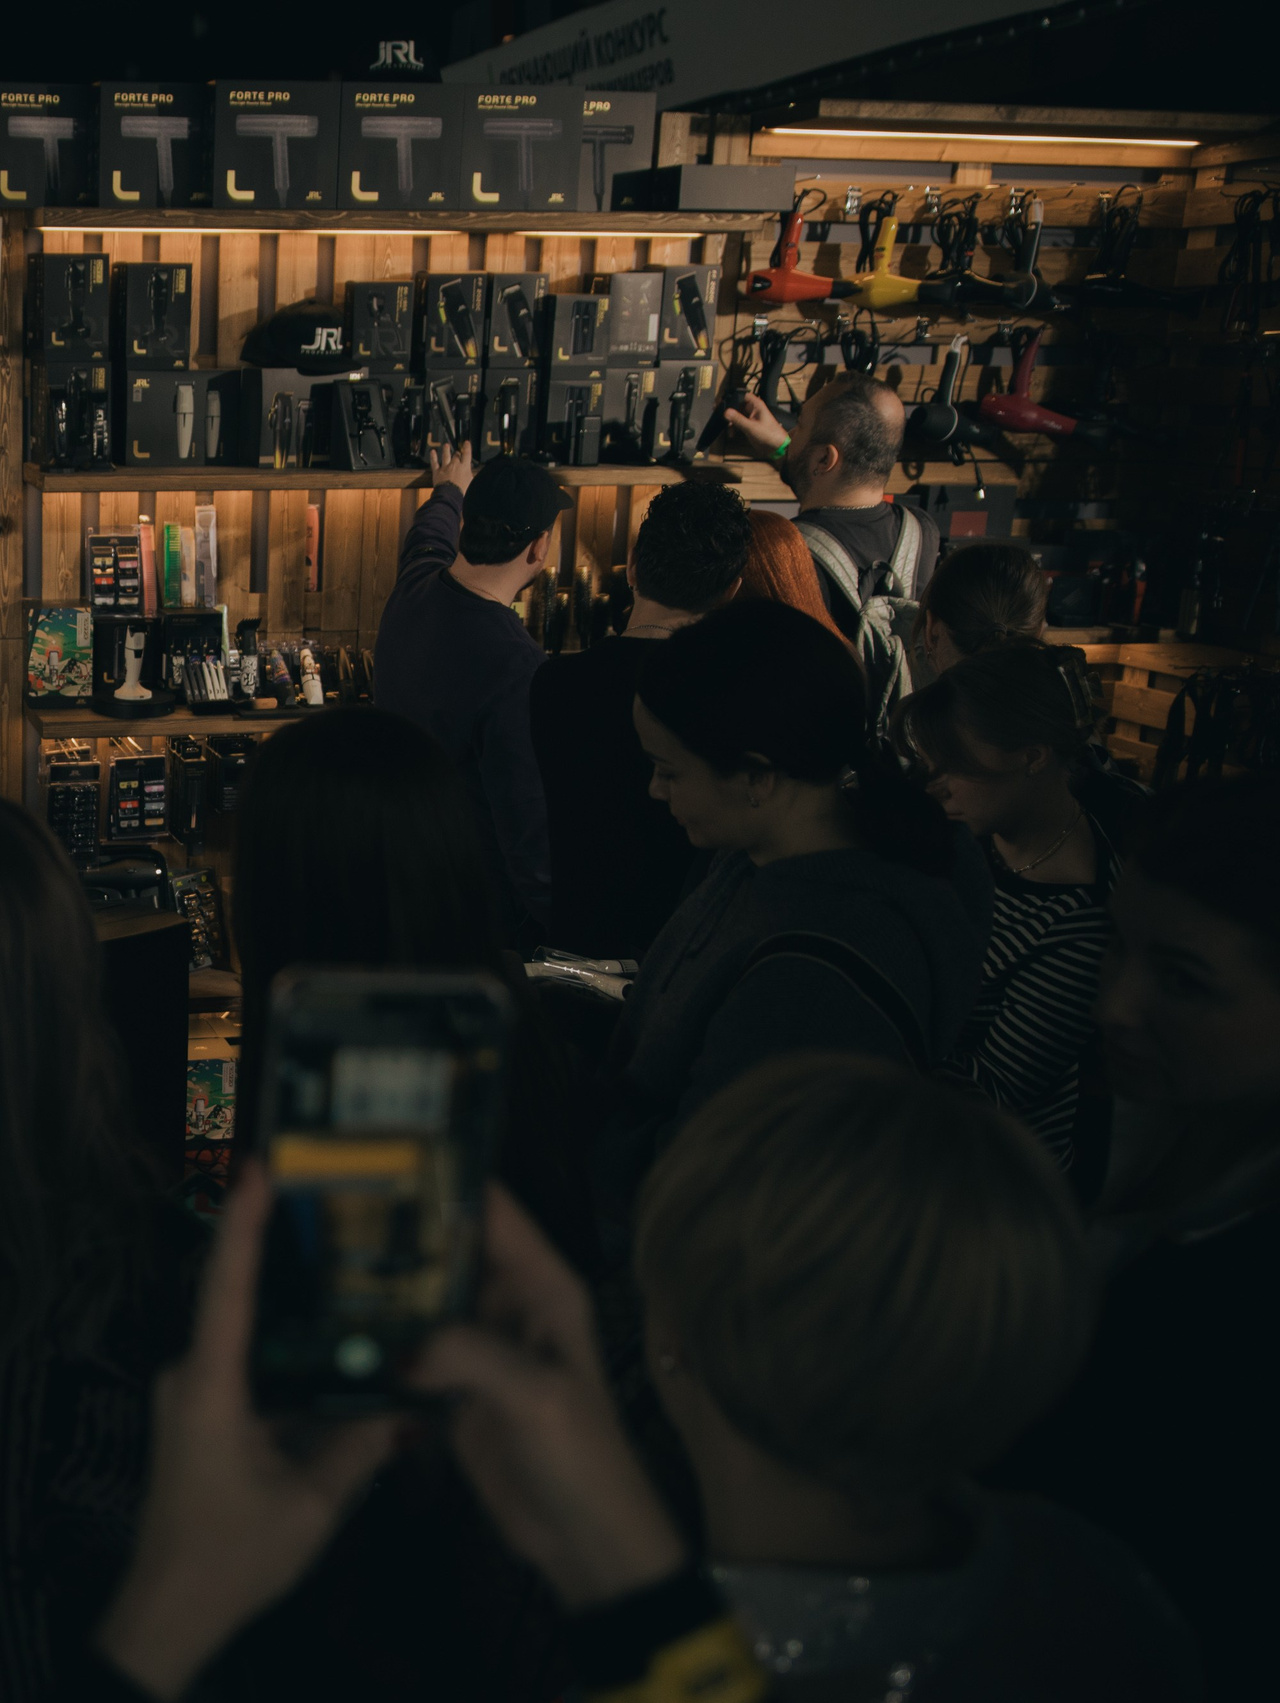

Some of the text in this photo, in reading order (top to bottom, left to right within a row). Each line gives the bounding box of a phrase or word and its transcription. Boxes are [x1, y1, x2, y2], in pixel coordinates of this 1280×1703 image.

[369, 40, 425, 69] JRL
[1, 92, 61, 105] FORTE PRO
[113, 92, 149, 103] FORTE
[151, 93, 175, 105] PRO
[229, 90, 291, 102] FORTE PRO
[355, 92, 416, 104] FORTE PRO
[477, 94, 538, 107] FORTE PRO
[588, 101, 612, 112] PRO
[300, 326, 344, 350] JRL
